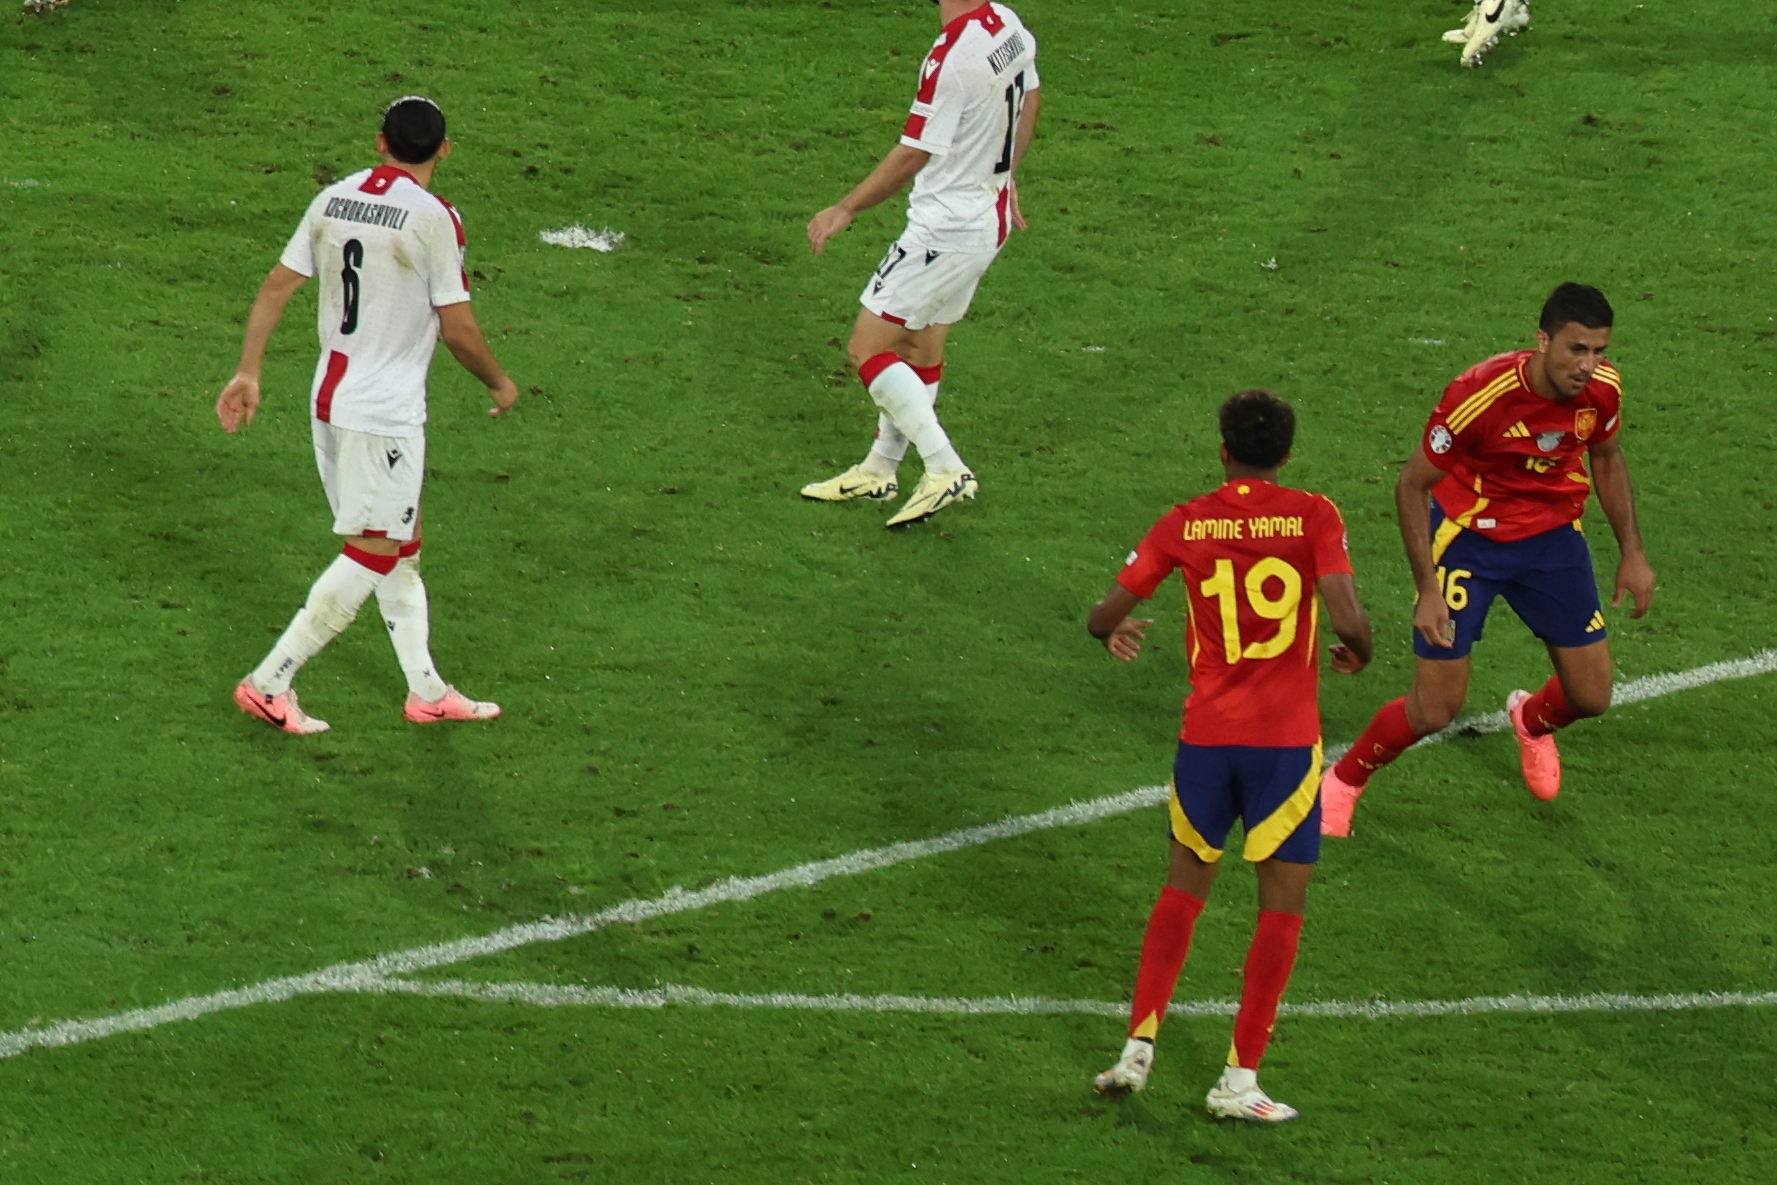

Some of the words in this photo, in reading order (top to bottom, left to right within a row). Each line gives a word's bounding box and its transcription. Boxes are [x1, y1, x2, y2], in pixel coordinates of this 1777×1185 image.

[339, 238, 364, 336] 6
[1182, 517, 1243, 541] LAMINE
[1248, 516, 1305, 539] YAMAL
[1200, 555, 1303, 665] 19
